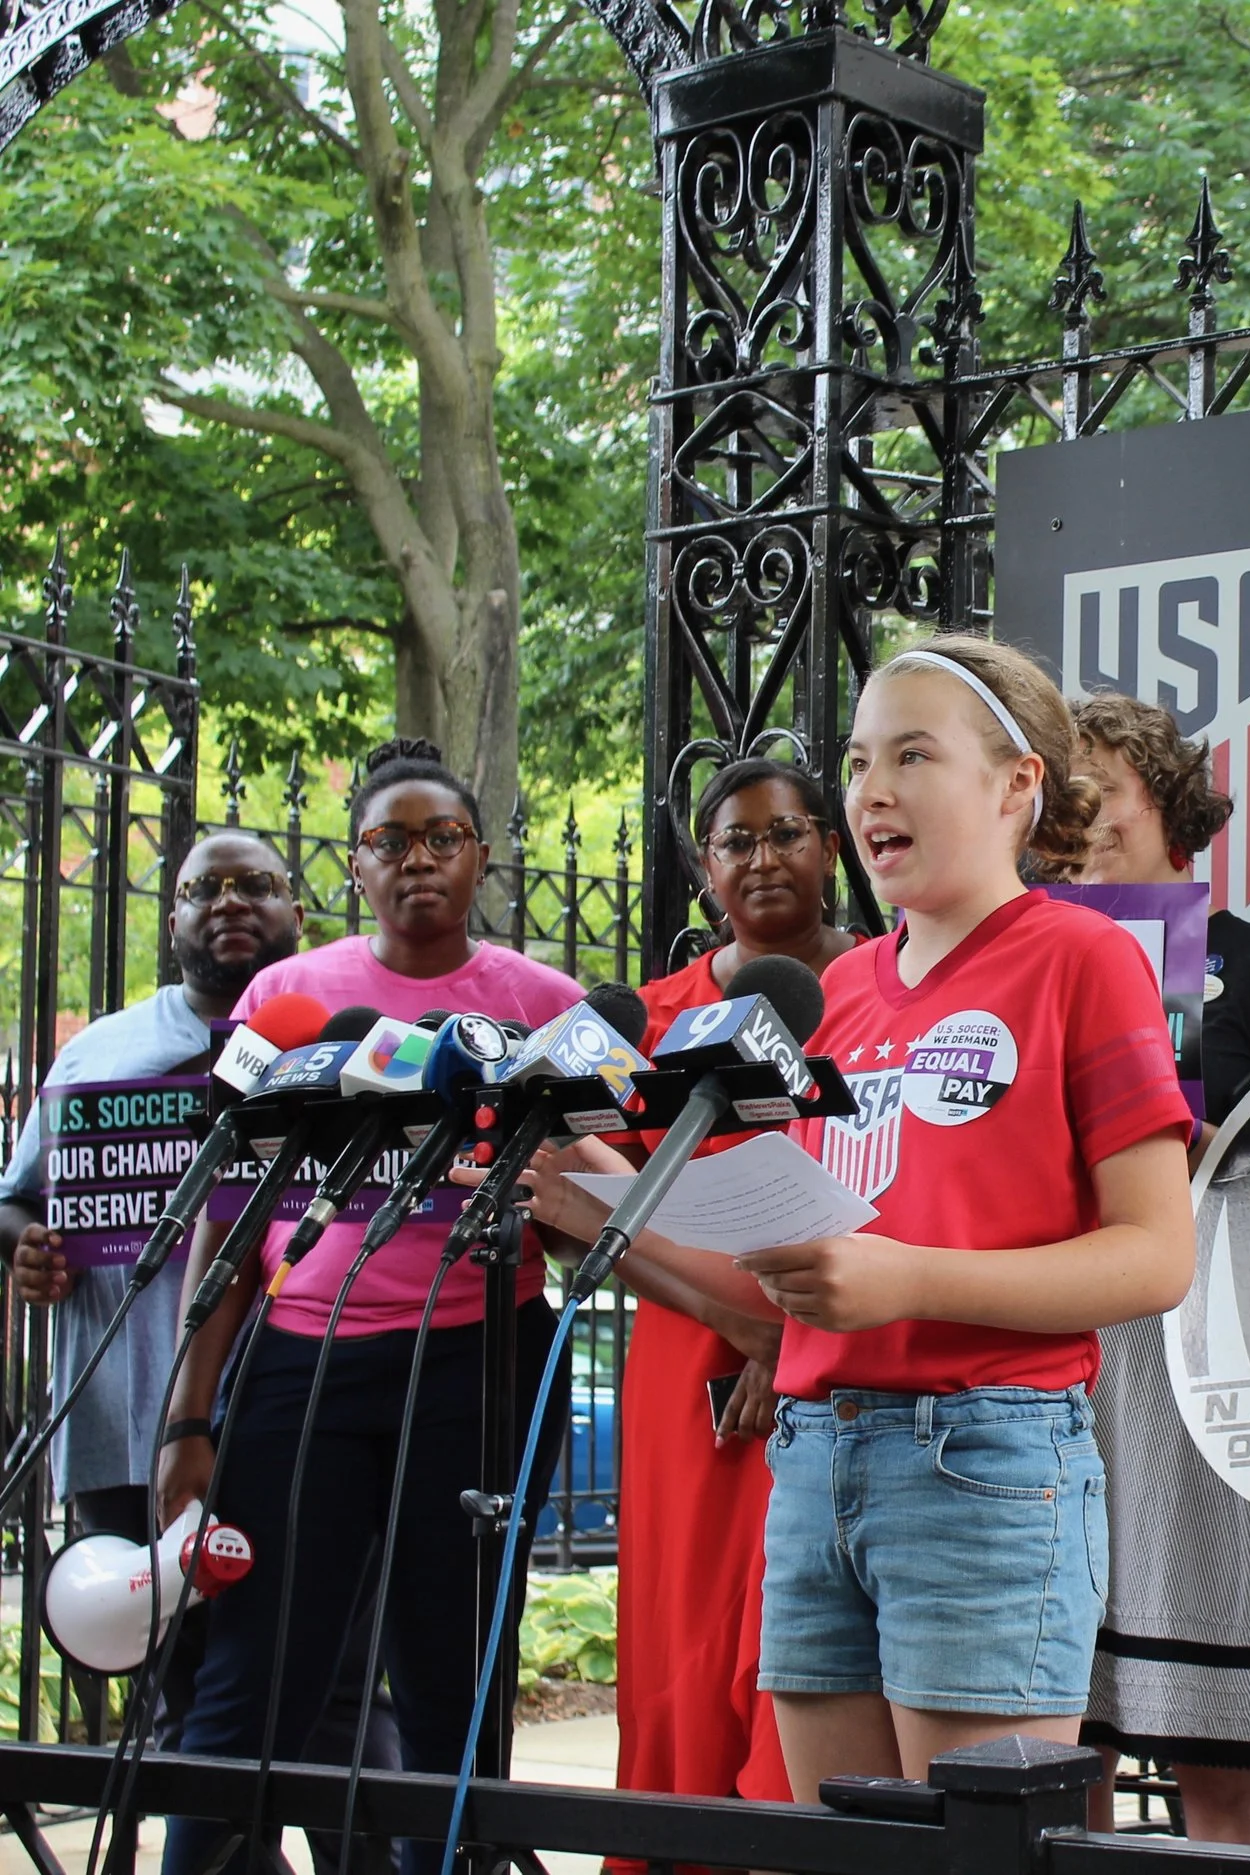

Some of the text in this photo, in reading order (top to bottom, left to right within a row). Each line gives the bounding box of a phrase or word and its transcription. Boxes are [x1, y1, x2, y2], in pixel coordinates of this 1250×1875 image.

[681, 1000, 733, 1051] 9
[933, 1035, 999, 1047] WE DEMAND
[936, 1024, 1002, 1037] U.S. SOCCER:
[304, 1045, 342, 1072] 5
[751, 1008, 810, 1096] WGN
[911, 1052, 985, 1074] EQUAL
[264, 1071, 322, 1088] NEWS
[597, 1047, 637, 1092] 2
[942, 1078, 994, 1103] PAY
[49, 1098, 91, 1133] U.S.
[47, 1146, 95, 1182] OUR
[47, 1191, 159, 1231] DESERVE
